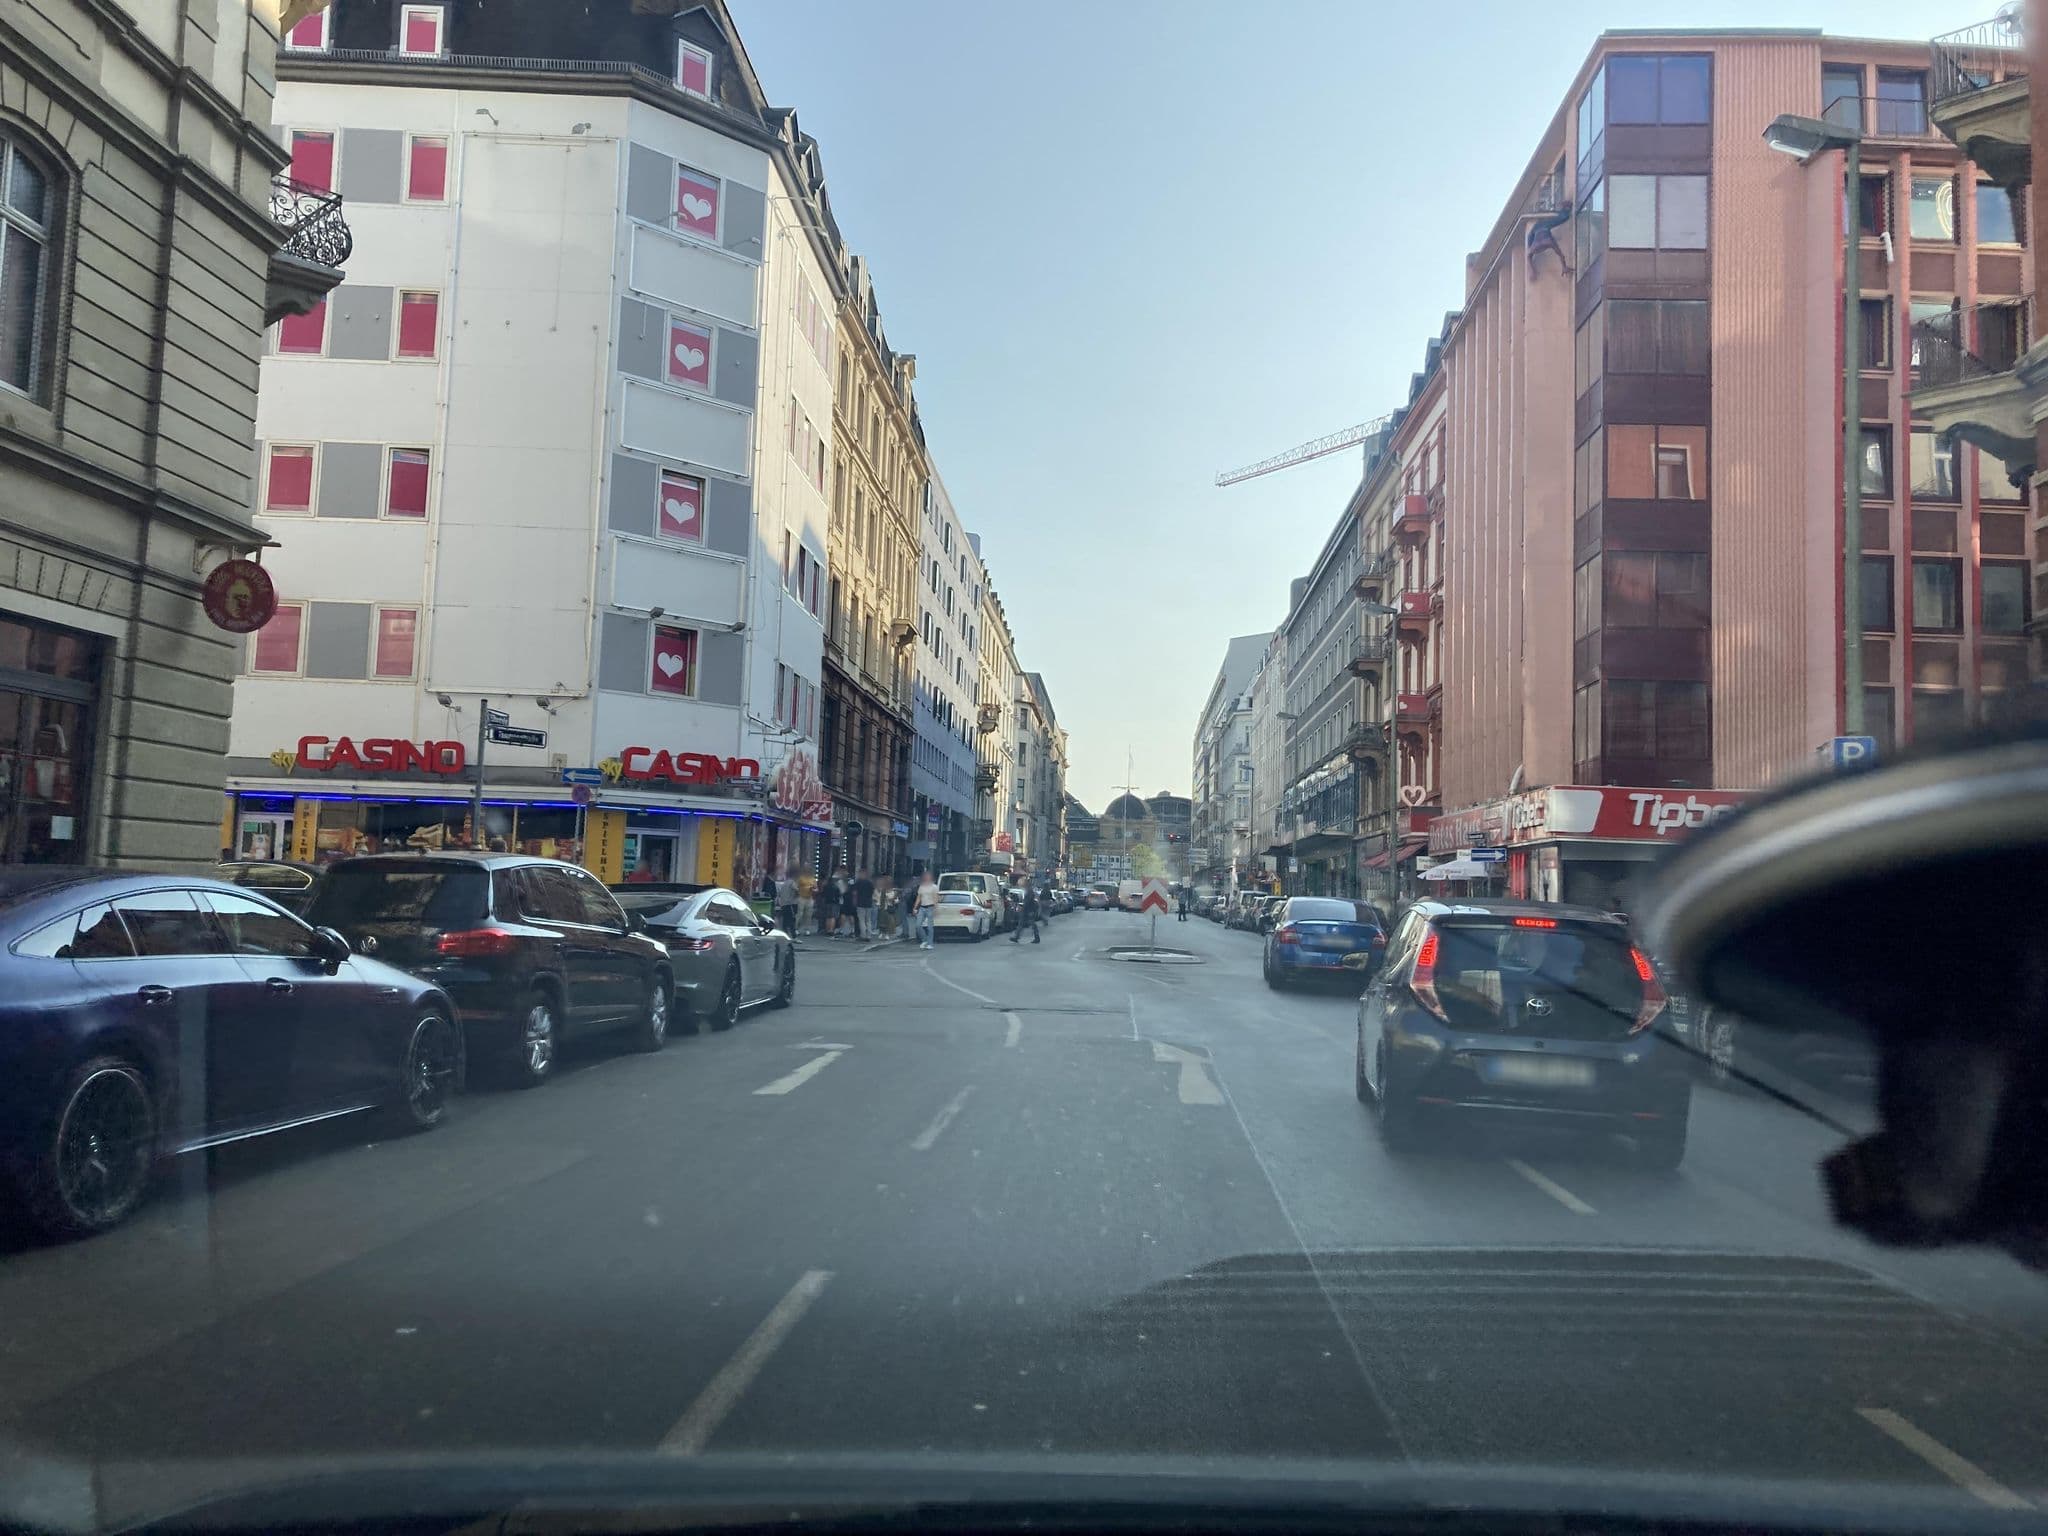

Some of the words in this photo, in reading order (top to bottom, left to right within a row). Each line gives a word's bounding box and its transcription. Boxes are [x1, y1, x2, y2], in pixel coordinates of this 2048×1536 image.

[297, 735, 465, 774] CASINO
[622, 746, 760, 784] CASINO
[1842, 741, 1865, 768] P
